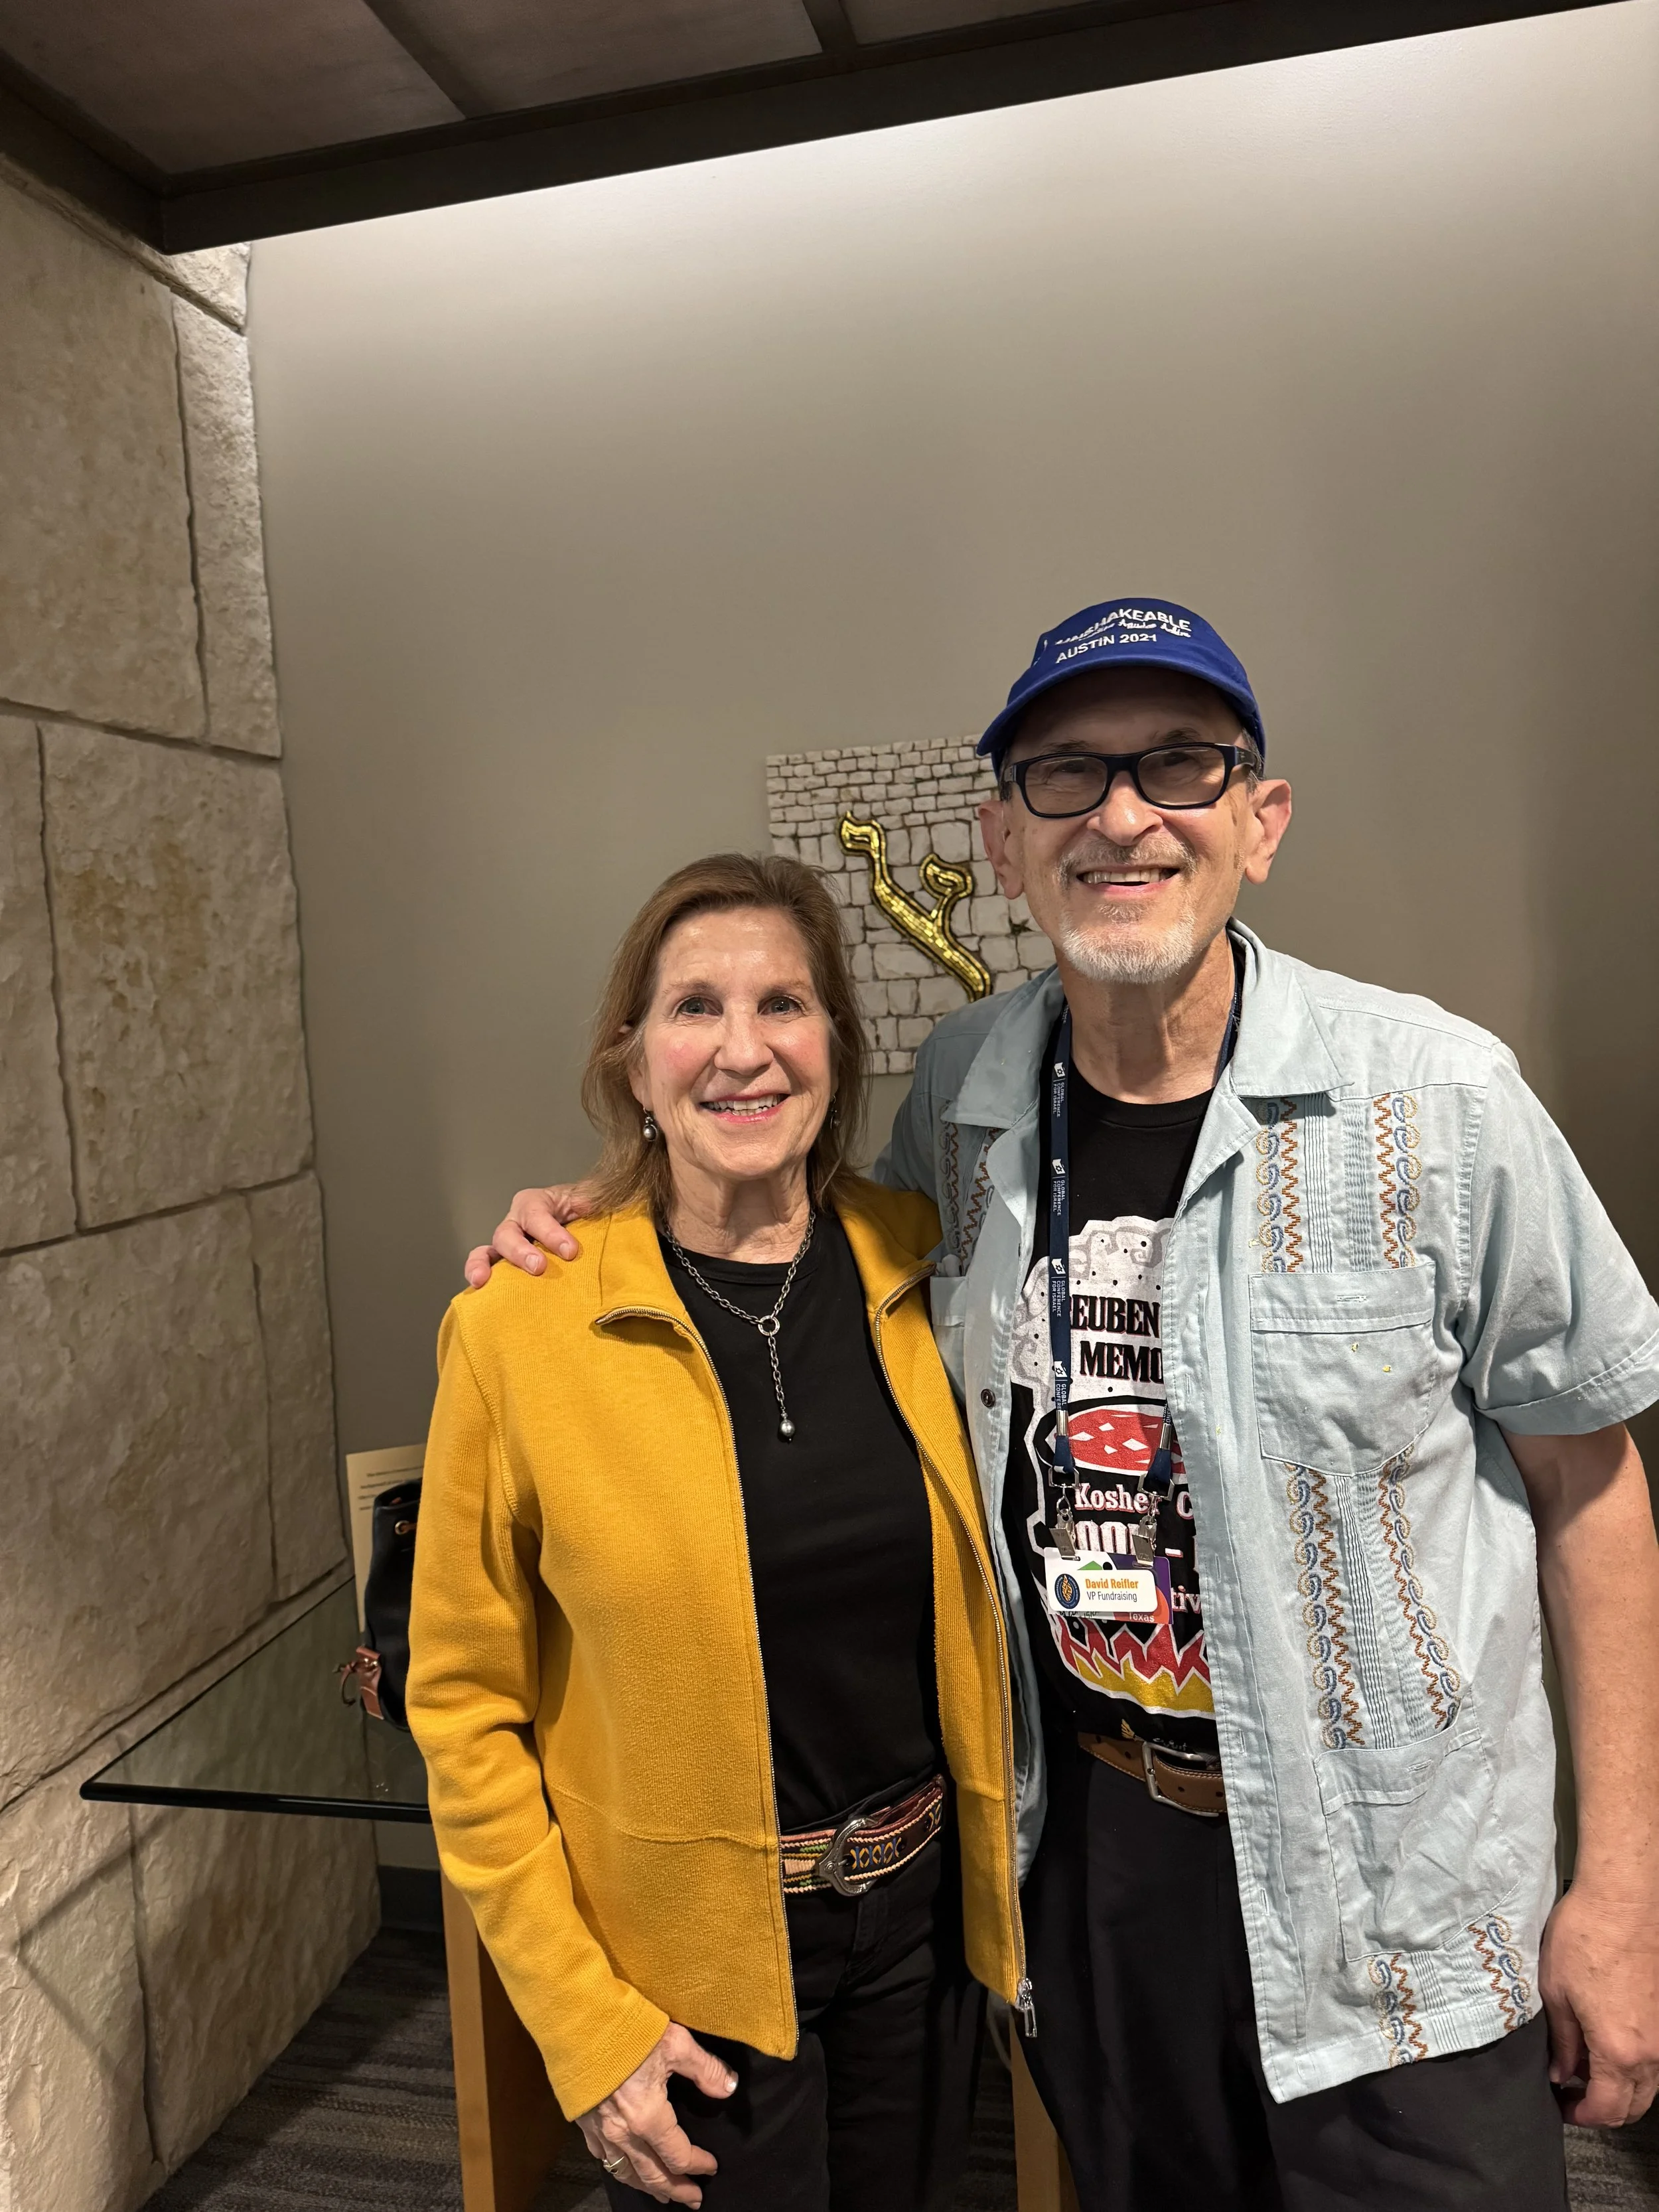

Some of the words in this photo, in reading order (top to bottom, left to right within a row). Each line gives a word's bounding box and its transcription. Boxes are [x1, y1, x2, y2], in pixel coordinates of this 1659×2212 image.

[1055, 634, 1115, 664] AUSTIN
[1119, 633, 1157, 644] 2021
[1070, 1293, 1161, 1339] EUBEN
[1085, 1578, 1109, 1589] David
[1111, 1578, 1139, 1589] Reifler
[1086, 1591, 1096, 1600] VP
[1098, 1591, 1138, 1602] Fundraising
